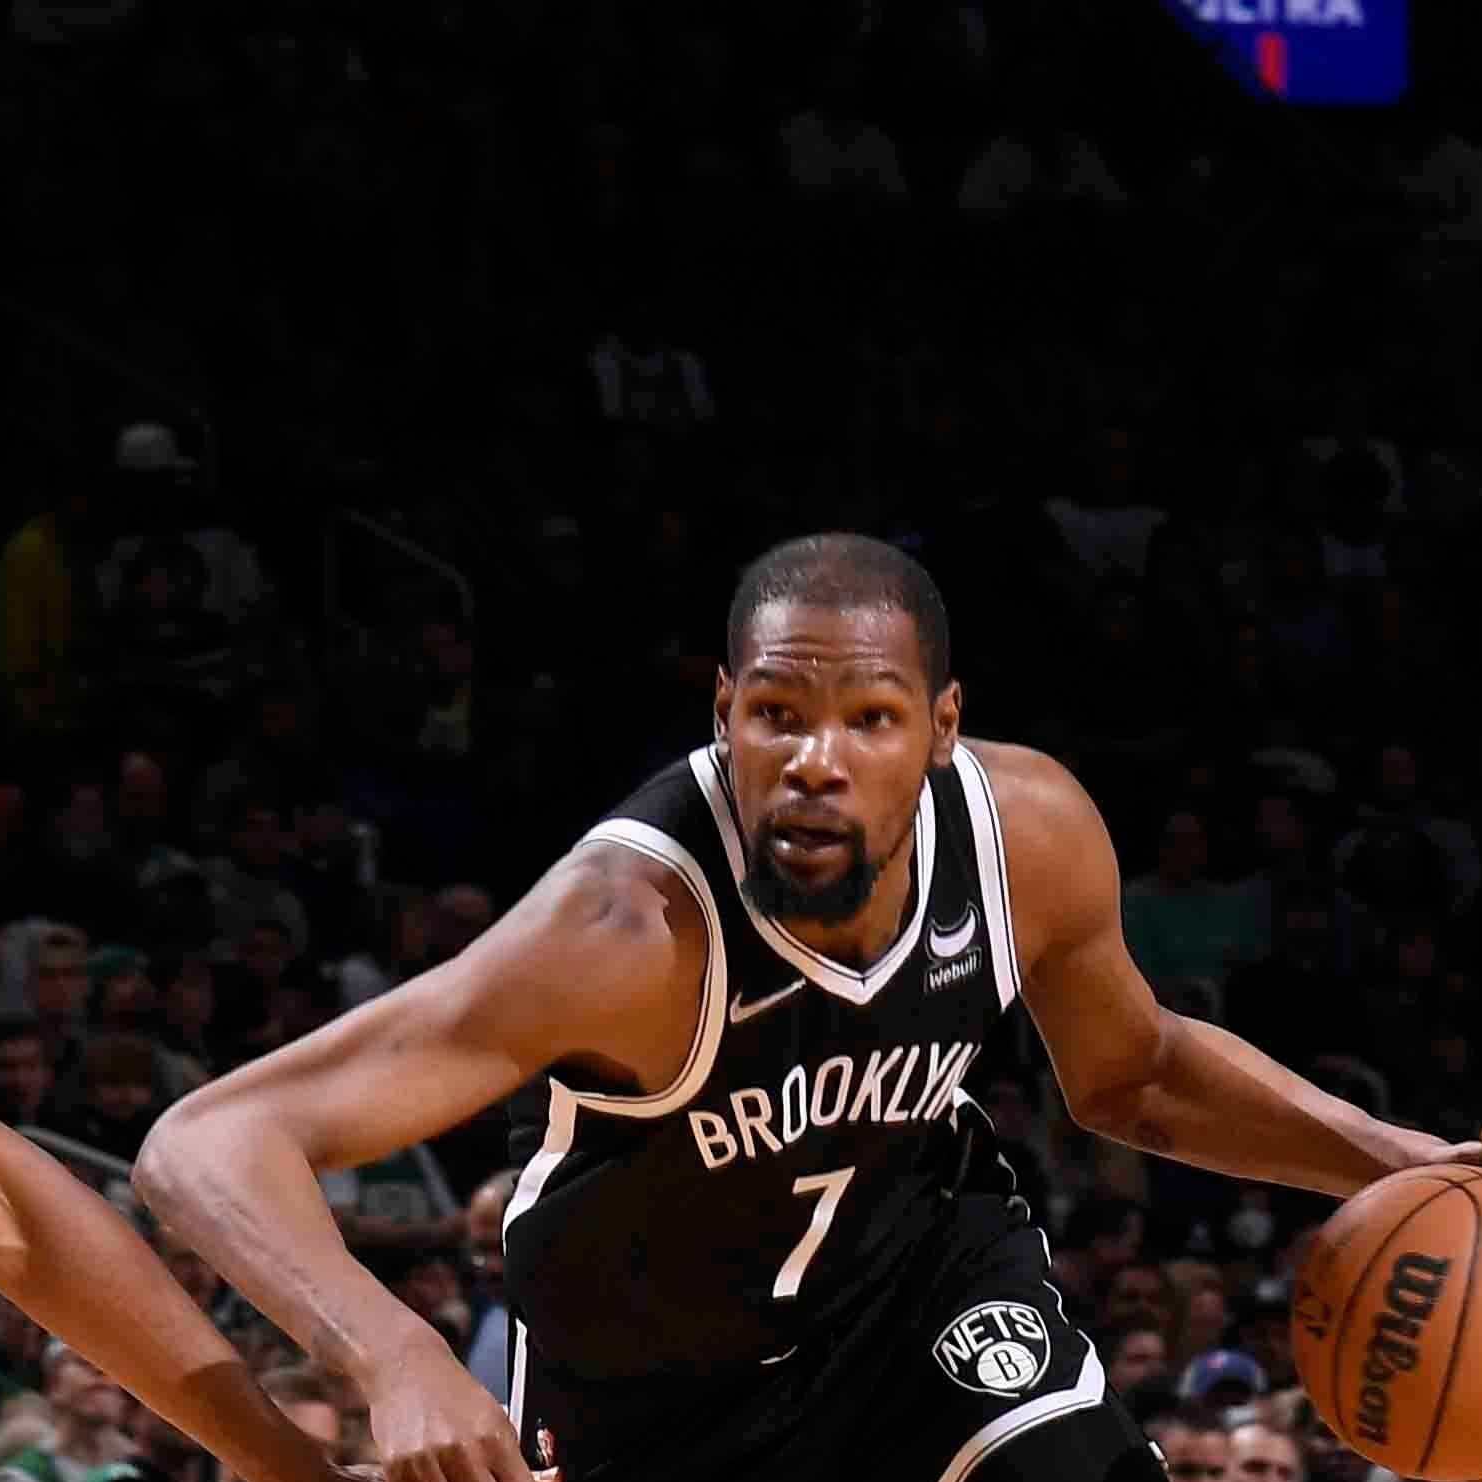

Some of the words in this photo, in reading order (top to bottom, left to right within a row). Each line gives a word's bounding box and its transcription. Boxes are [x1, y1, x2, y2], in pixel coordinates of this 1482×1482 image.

[927, 949, 979, 990] Webull
[771, 1165, 856, 1299] 7
[939, 1305, 1046, 1376] NETS
[992, 1350, 1022, 1382] B
[1357, 1252, 1451, 1446] Wilson
